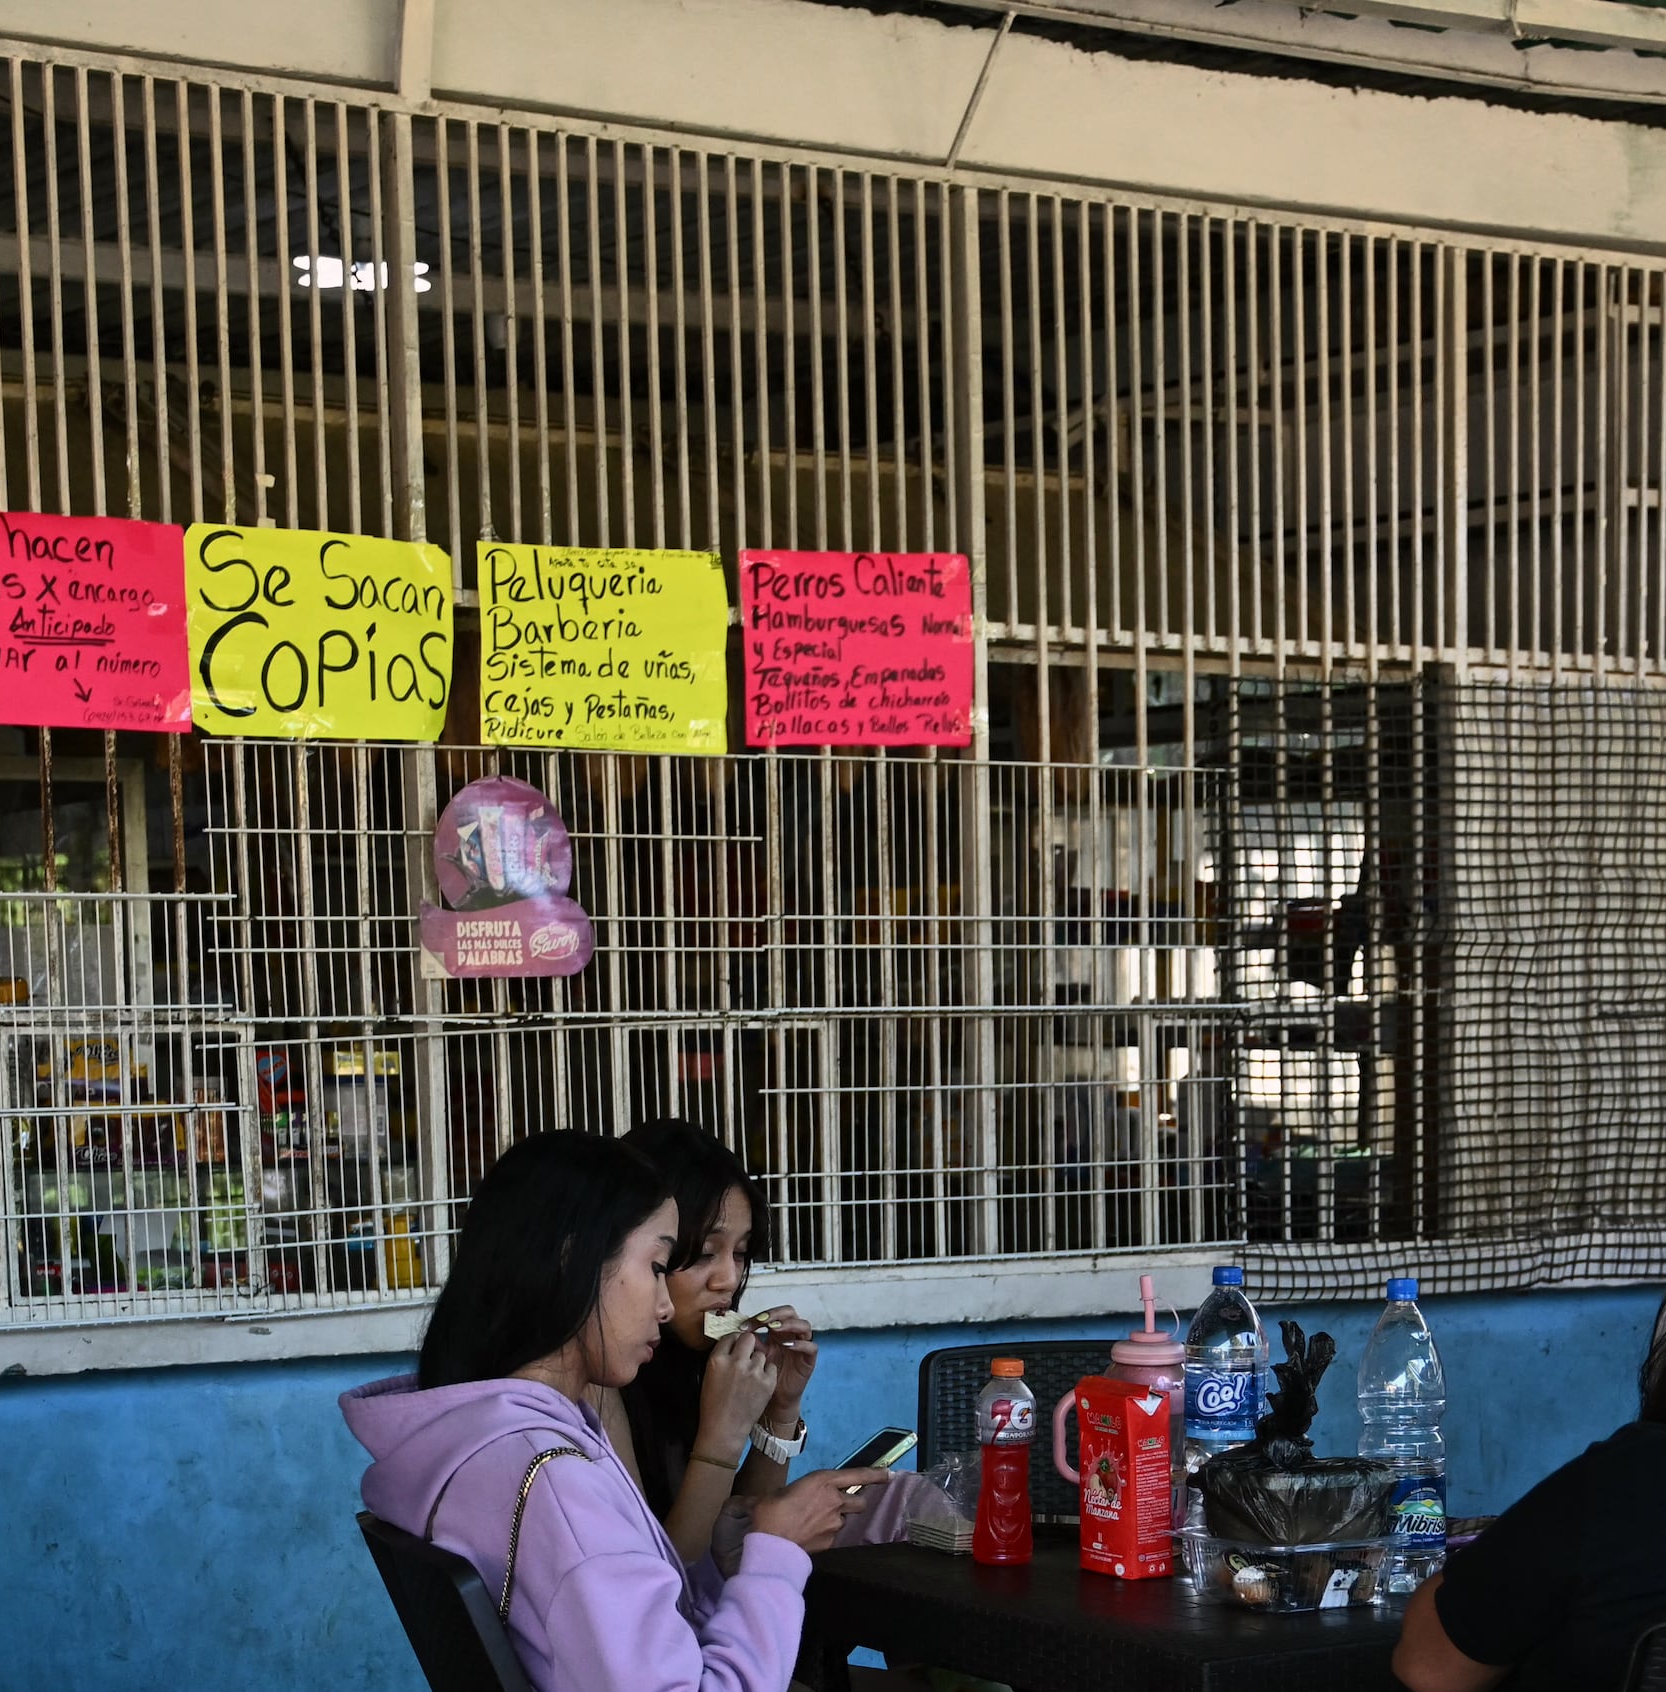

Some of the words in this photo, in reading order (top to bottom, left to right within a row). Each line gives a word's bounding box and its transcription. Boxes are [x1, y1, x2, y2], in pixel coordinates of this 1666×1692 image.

[199, 530, 296, 612] Se
[320, 540, 444, 620] Sacan
[485, 549, 663, 615] Peluqueria
[749, 562, 846, 601] Perros
[853, 554, 946, 599] Caliente
[486, 603, 643, 652] Barberia
[751, 602, 906, 639] Hamburguesas
[55, 650, 81, 672] al
[486, 646, 592, 681] Sistema
[597, 648, 630, 679] de
[773, 638, 842, 664] Especial
[564, 701, 574, 725] y
[456, 920, 523, 938] DISFRUTA
[457, 939, 473, 950] LAS
[474, 936, 492, 950] MÁS
[493, 939, 523, 950] DULCES
[530, 924, 579, 958] Savoy
[457, 951, 524, 967] PALABRAS
[1196, 1374, 1245, 1414] Cool
